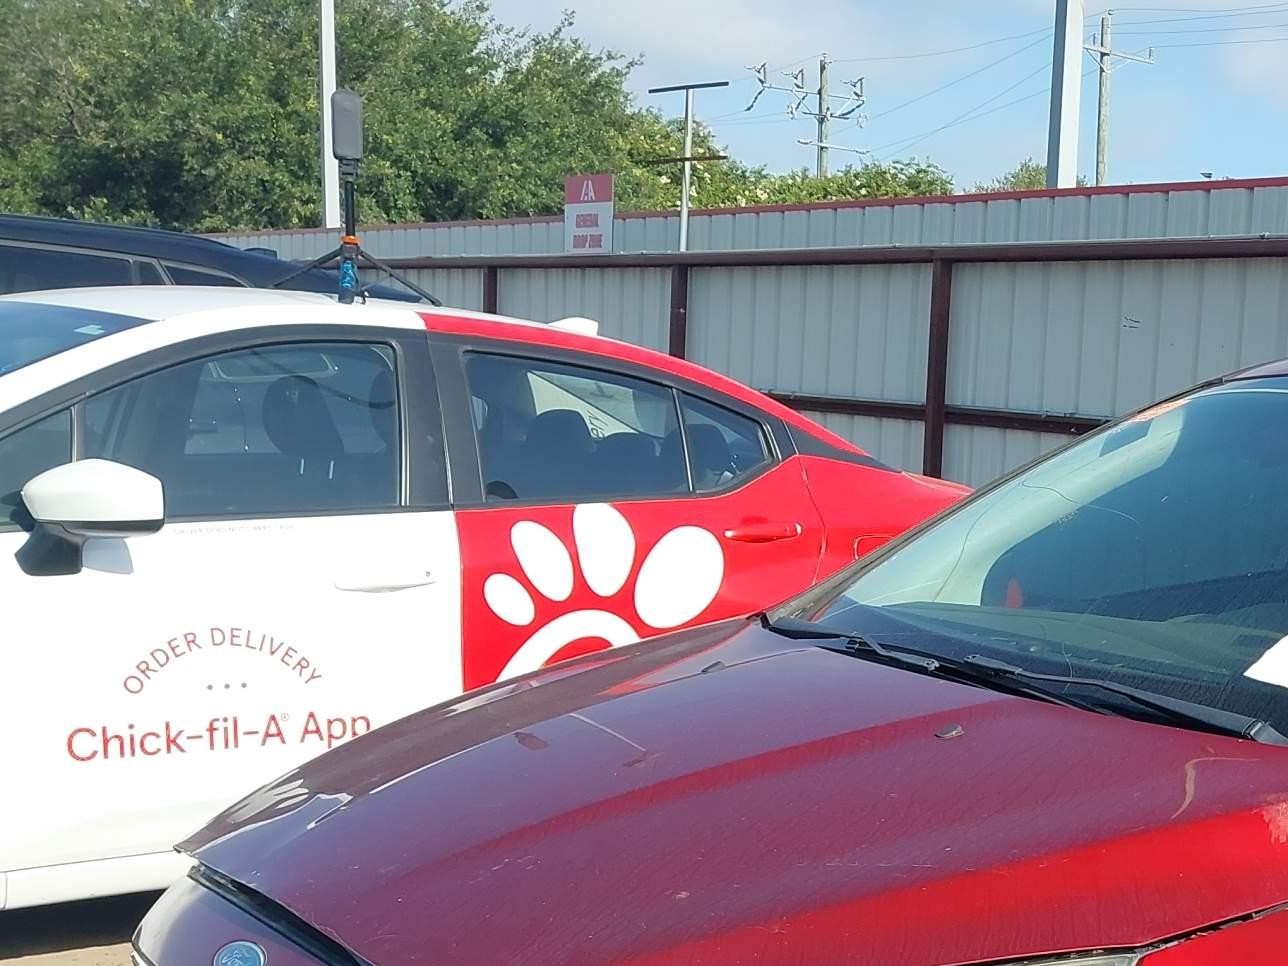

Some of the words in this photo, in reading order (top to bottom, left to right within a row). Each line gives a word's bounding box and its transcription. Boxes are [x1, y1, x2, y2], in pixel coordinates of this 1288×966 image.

[123, 631, 203, 695] ORDER
[210, 627, 323, 687] DELIVERY
[300, 711, 371, 749] App
